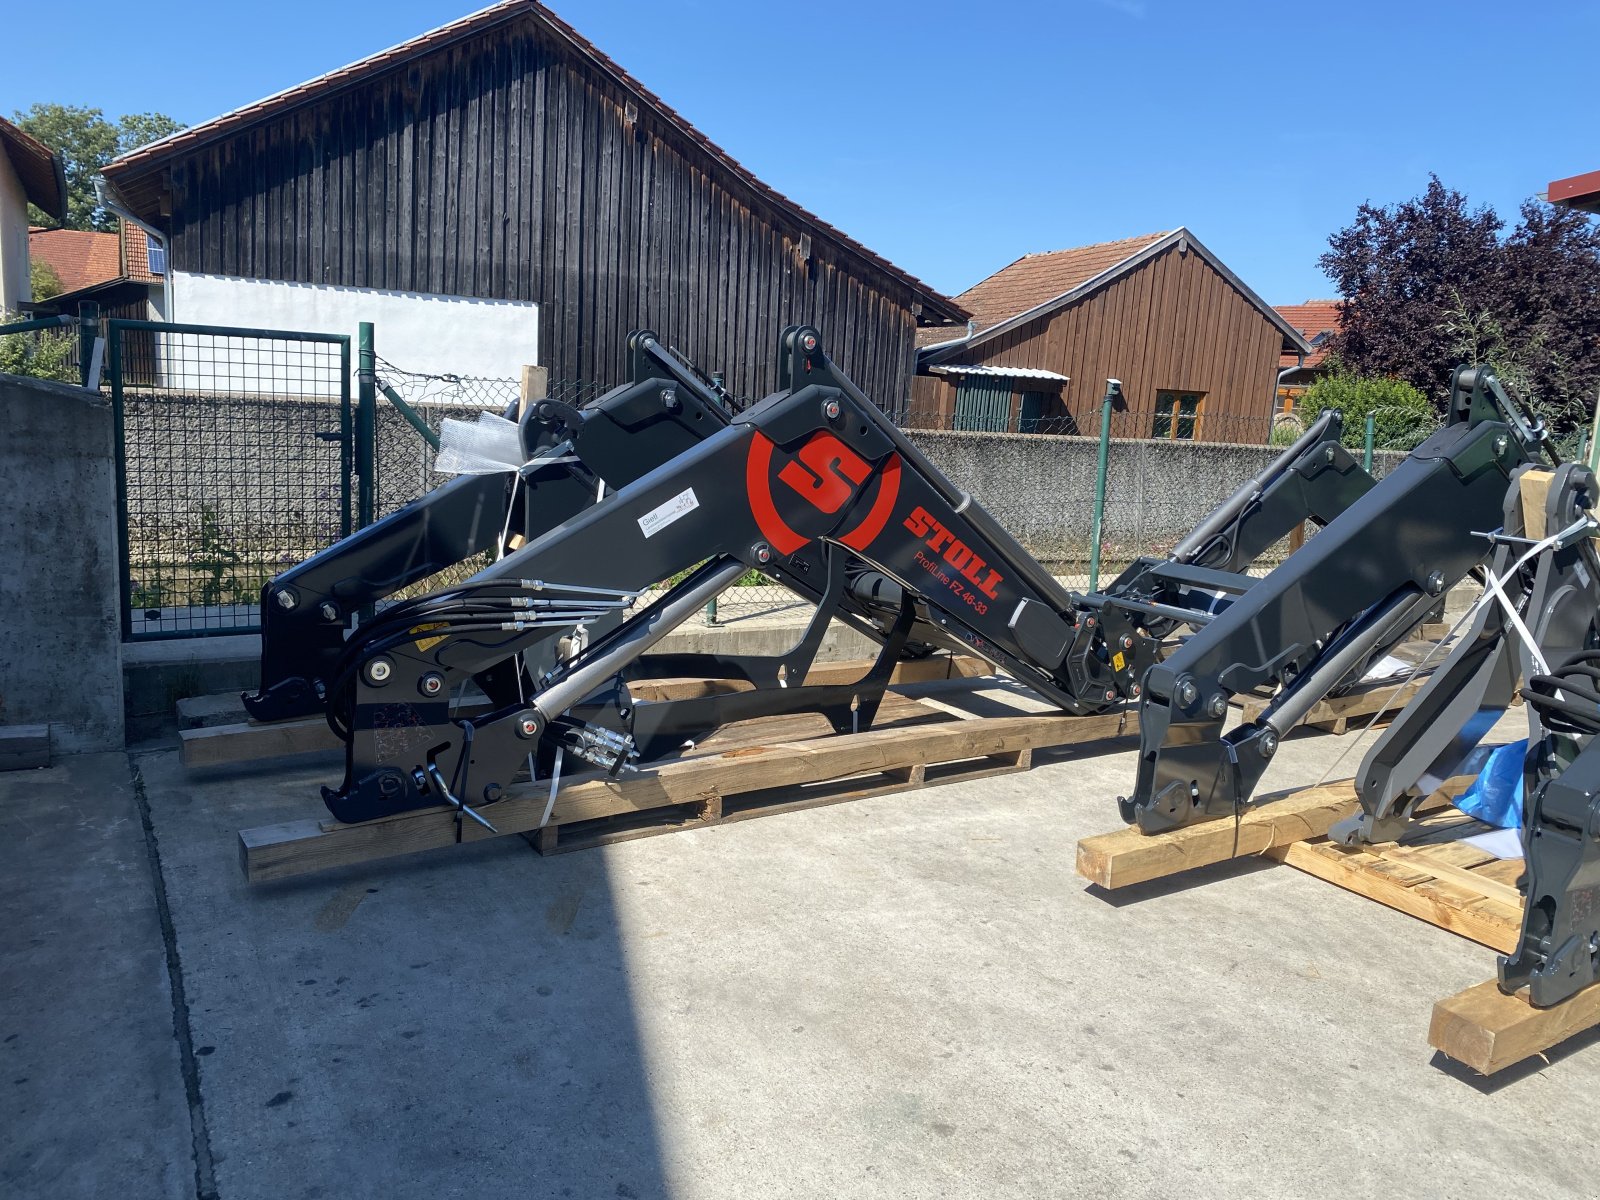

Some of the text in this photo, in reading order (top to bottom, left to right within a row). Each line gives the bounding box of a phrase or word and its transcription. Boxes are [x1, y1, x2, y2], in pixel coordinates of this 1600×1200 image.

[903, 506, 1004, 600] STOLL
[913, 551, 988, 615] ProfiLine FZ 46-33
